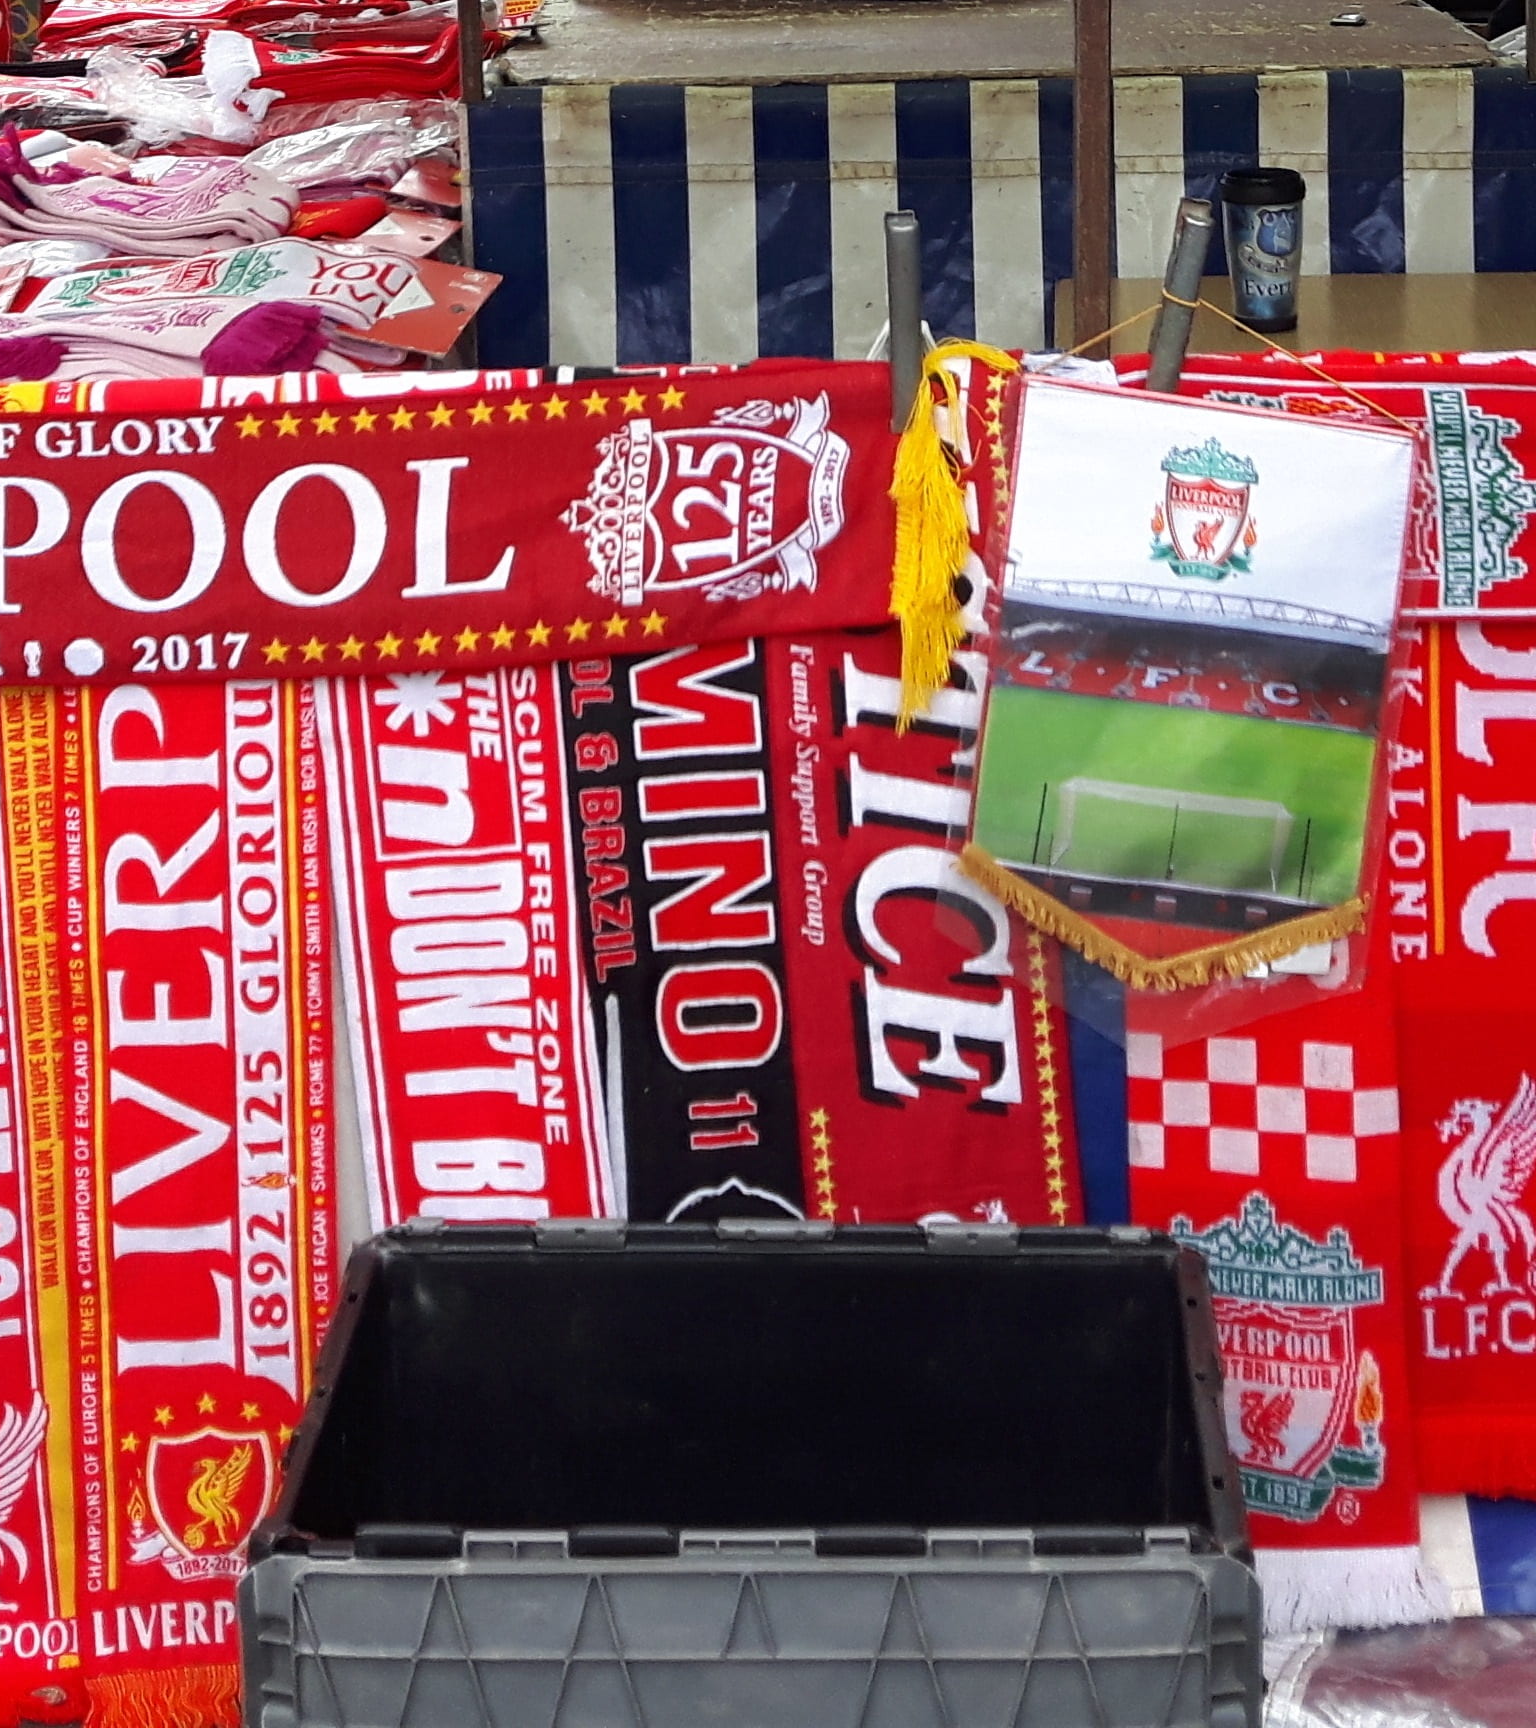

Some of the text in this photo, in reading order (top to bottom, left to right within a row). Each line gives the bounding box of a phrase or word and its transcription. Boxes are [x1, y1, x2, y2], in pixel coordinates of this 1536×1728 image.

[35, 416, 223, 459] GLORY
[622, 418, 651, 605] LIVERPOOL
[676, 441, 745, 573] 125
[747, 445, 780, 555] YEARS
[133, 633, 249, 672] 2017
[579, 787, 637, 981] BRAZIL
[629, 644, 782, 1071] MINO
[790, 644, 829, 946] Family Support Group
[1388, 742, 1428, 961] ALONE
[306, 904, 322, 1018] TOMMY SMITH
[385, 860, 539, 1105] DON'T
[512, 667, 569, 1144] SCUM FREE ZONE
[97, 683, 236, 1374] LIVERP
[232, 683, 288, 1365] 1892 125 GLORIOU
[689, 1094, 758, 1149] 11
[79, 1295, 103, 1593] CHAMPIONS OF EUROPE 5 TIMES
